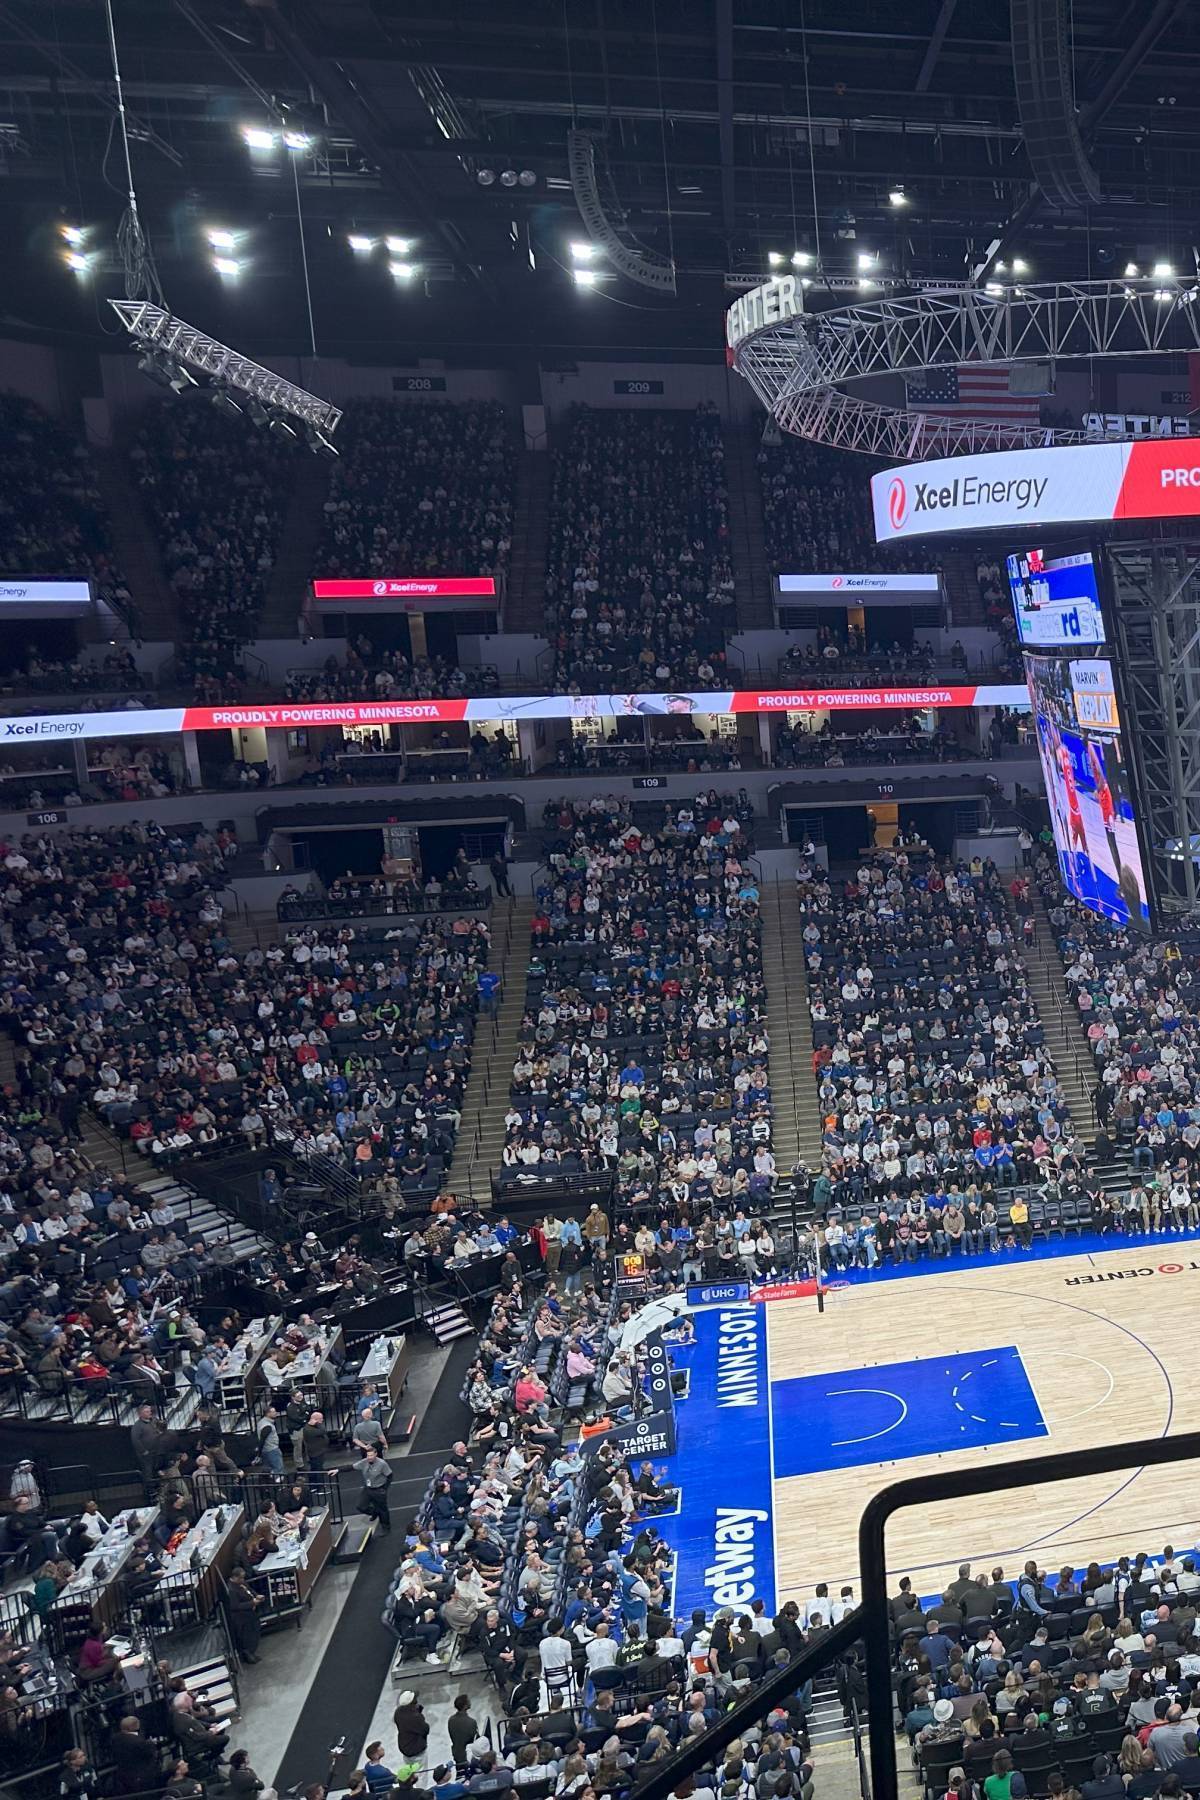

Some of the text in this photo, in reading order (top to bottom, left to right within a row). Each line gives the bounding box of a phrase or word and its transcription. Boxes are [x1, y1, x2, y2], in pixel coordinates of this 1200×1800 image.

[407, 379, 431, 390] 208
[628, 382, 650, 392] 209
[914, 479, 960, 512] Xcel
[962, 477, 1048, 510] Energy
[758, 692, 952, 707] PROUDLY POWERING MINNESOTA
[5, 705, 440, 736] Xcel Energy PROUDLY POWERING MINNESOTA
[641, 778, 659, 788] 109
[877, 785, 894, 793] 110
[38, 813, 58, 824] 106
[1064, 1267, 1155, 1286] CENTER
[711, 1289, 736, 1299] UHC
[716, 1297, 760, 1408] MINNESOTA
[618, 1433, 666, 1448] TARGET
[623, 1441, 667, 1455] CENTER
